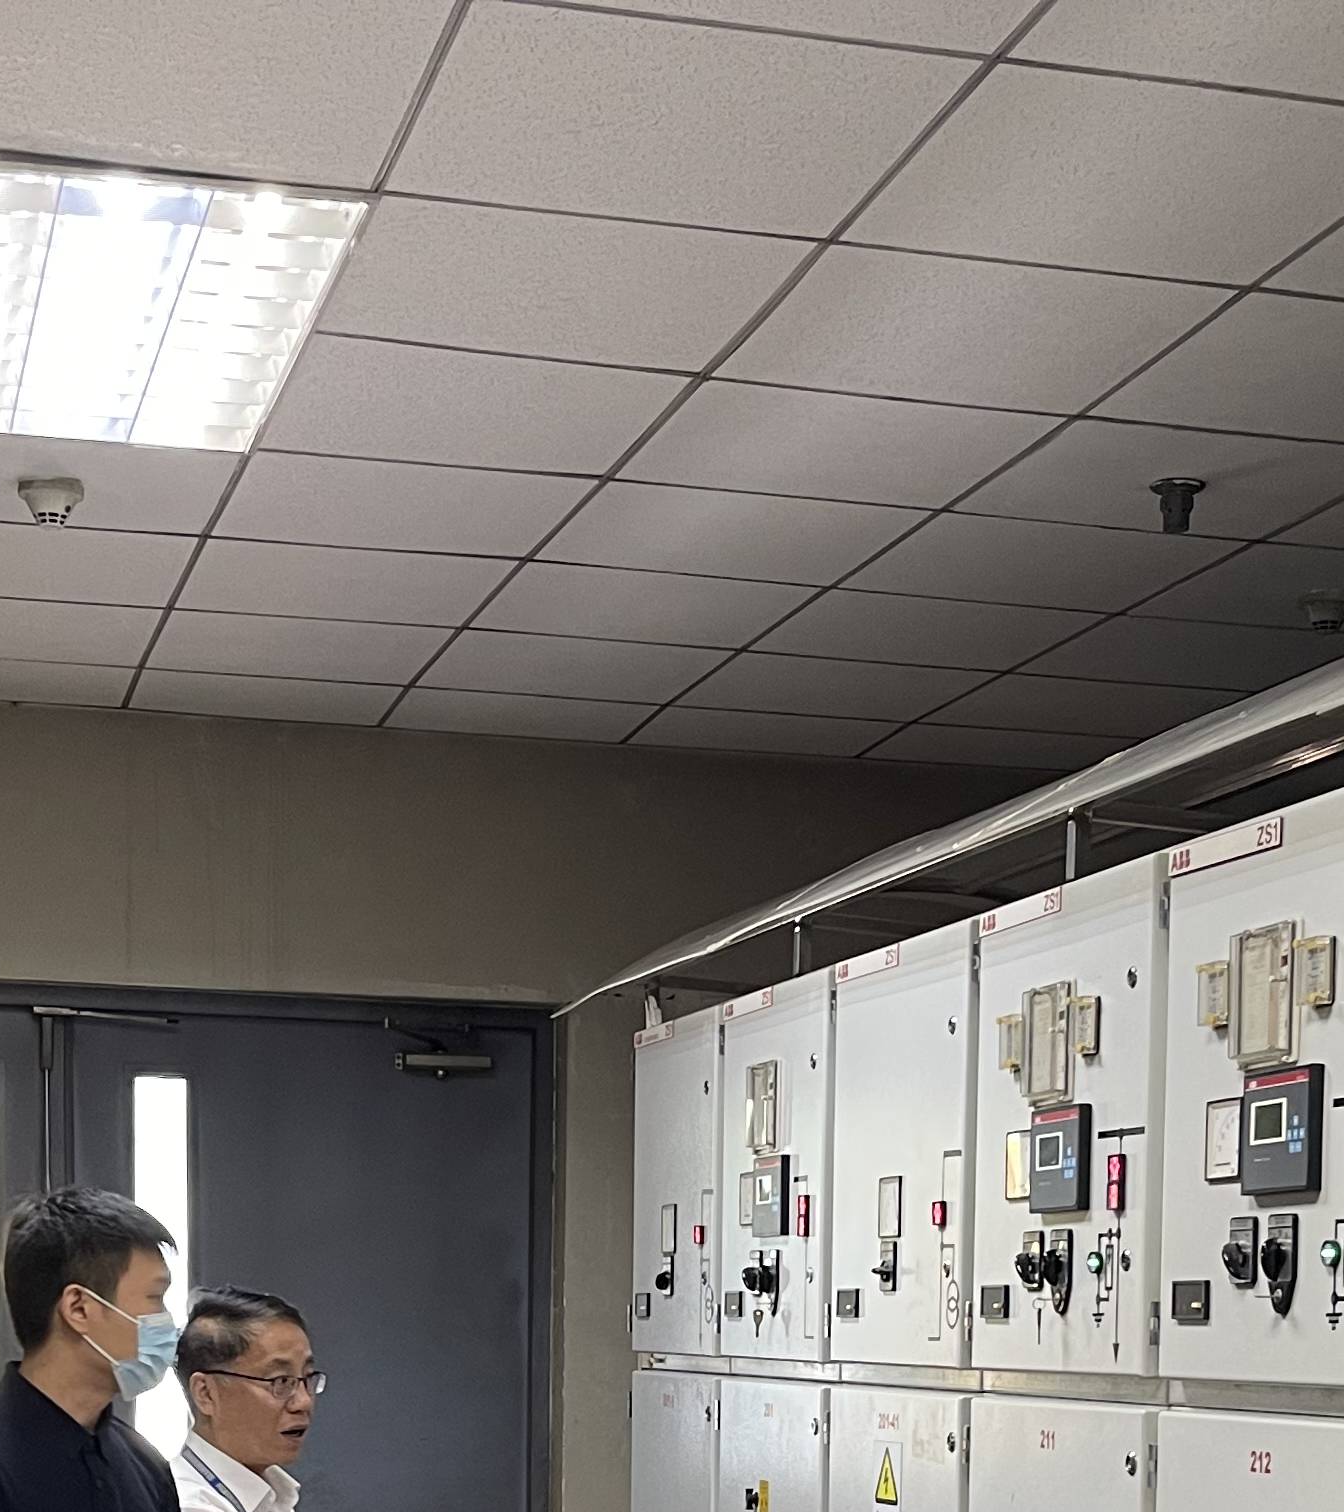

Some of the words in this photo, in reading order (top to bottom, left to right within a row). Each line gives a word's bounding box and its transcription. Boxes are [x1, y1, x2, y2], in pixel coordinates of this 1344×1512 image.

[1170, 848, 1192, 873] ABB
[1256, 823, 1280, 847] ZS1
[1043, 890, 1060, 912] ZS1
[1040, 1429, 1056, 1451] 211
[1250, 1450, 1272, 1475] 212
